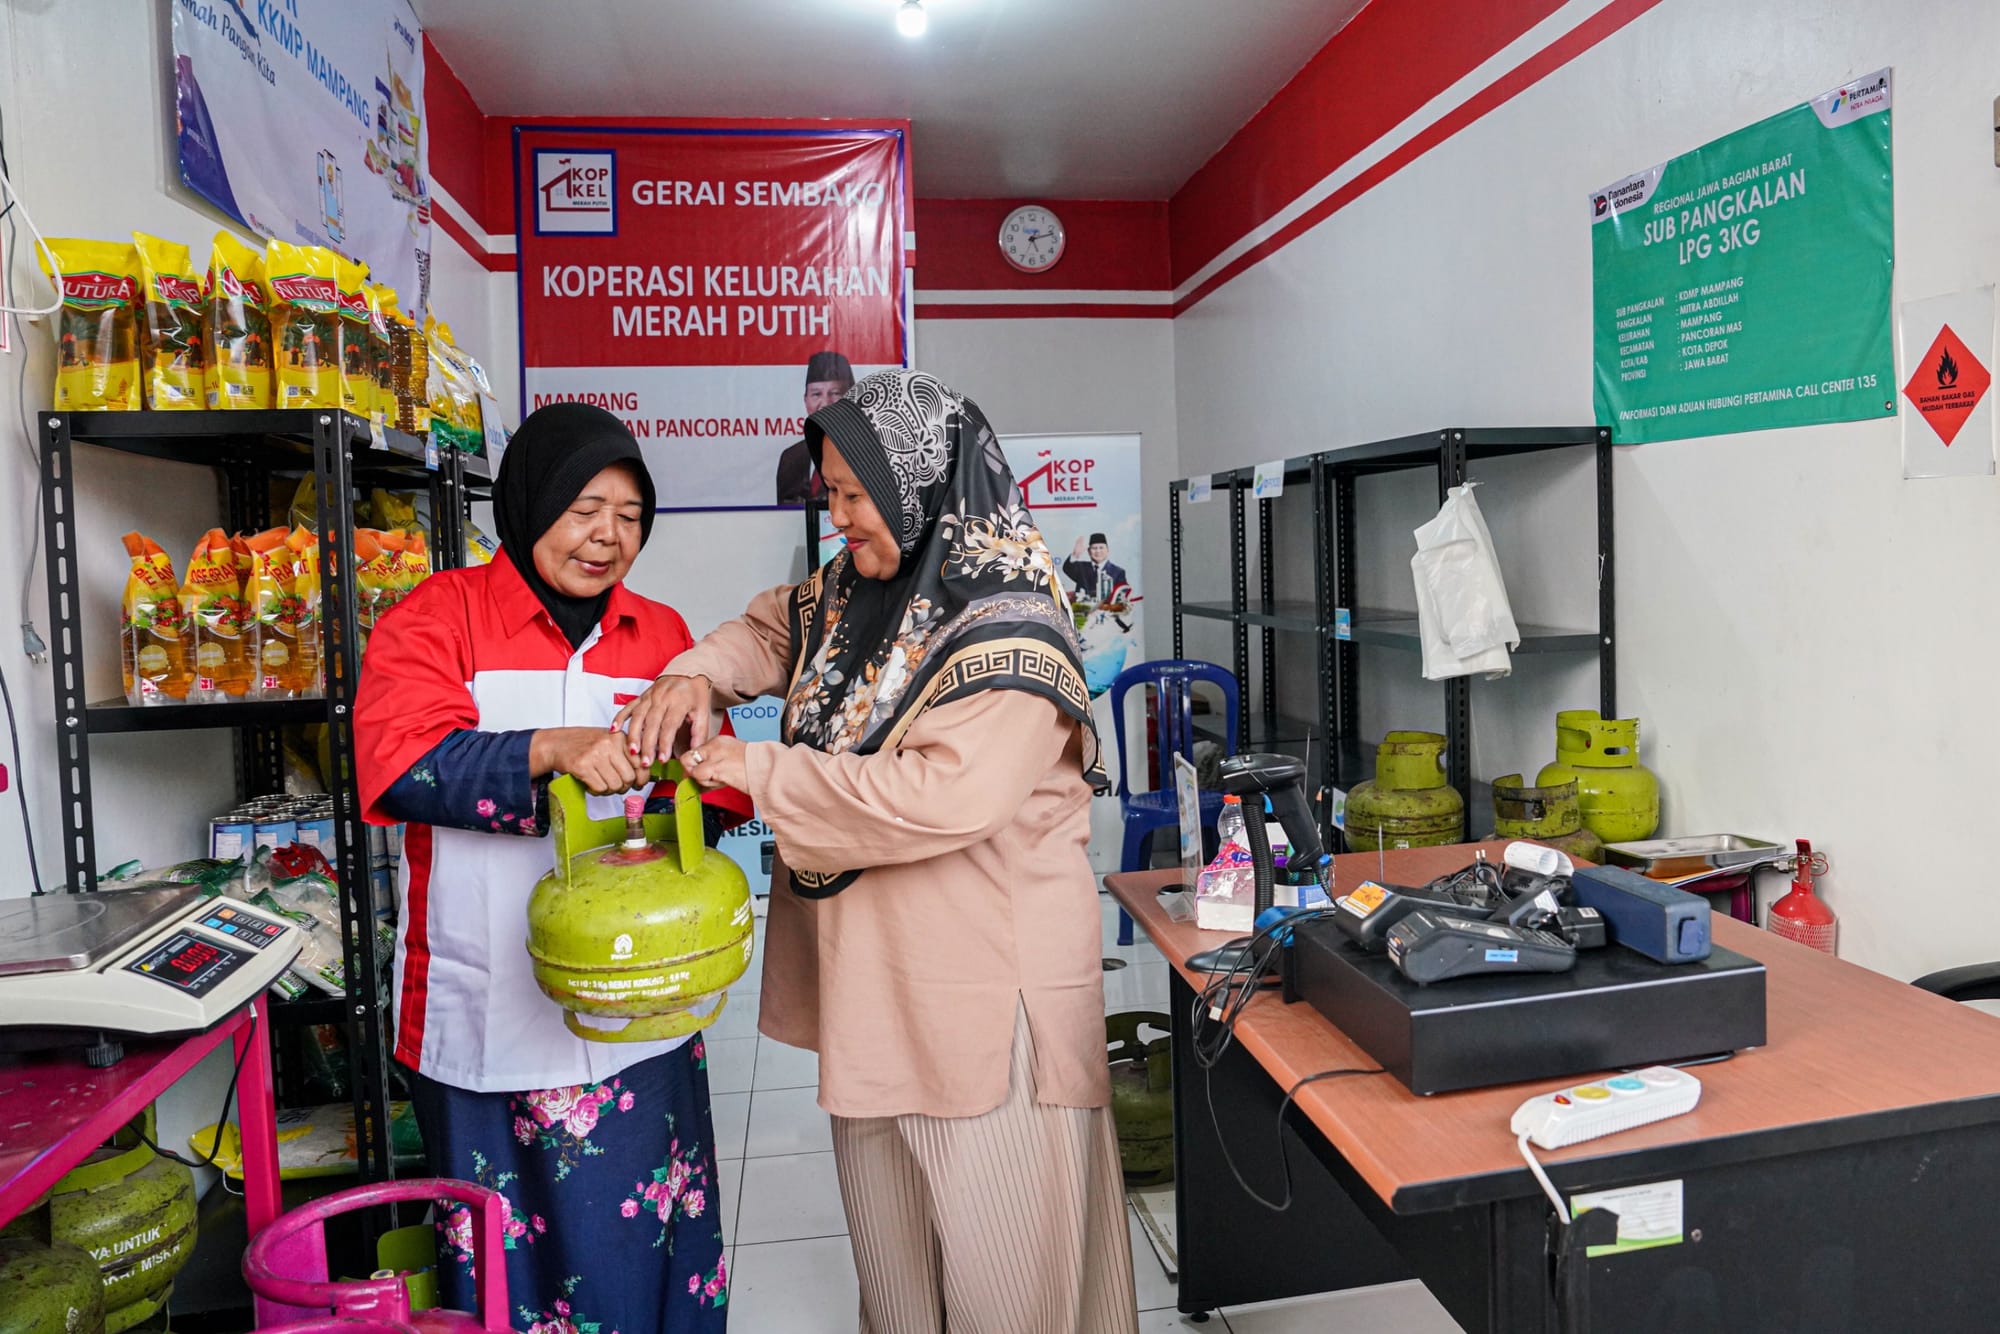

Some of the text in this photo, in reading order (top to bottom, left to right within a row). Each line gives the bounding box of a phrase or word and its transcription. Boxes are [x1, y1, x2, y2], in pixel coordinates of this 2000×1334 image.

[221, 13, 257, 67] Pangan
[257, 52, 276, 87] Kita
[257, 2, 370, 129] KKMP MAMPANG
[572, 167, 609, 181] KOP
[1653, 152, 1793, 215] REGIONAL JAWA BAGIAN BARAT
[572, 184, 607, 197] KEL
[631, 179, 886, 208] GERAI SEMBAKO
[1643, 168, 1806, 247] SUB PANGKALAN
[1679, 218, 1761, 266] LPG 3KG
[63, 279, 131, 299] UTURA
[543, 264, 889, 298] KOPERASI KELURAHAN
[1626, 296, 1665, 315] PANGKALAN
[1701, 276, 1744, 296] MAMPANG
[612, 304, 831, 338] MERAH PUTIH
[1616, 292, 1739, 330] PANGKALAN MITRA ABDILLAH
[1680, 311, 1723, 329] MAMPANG
[1620, 321, 1743, 356] KECAMATAN PANCORAN MAS
[1682, 344, 1703, 357] KOTA
[1704, 339, 1728, 353] DEPOK
[1621, 353, 1729, 382] PROVINSI JAWA BARAT
[534, 392, 639, 412] MAMPANG
[1619, 374, 1877, 421] INFORMASI DAN ADUAN HUBUNGI PERTAMINA CALL CENTER 135
[1962, 390, 1975, 399] GAS
[655, 418, 759, 438] PANCORAN
[764, 417, 806, 436] MAS
[1053, 459, 1095, 475] KOP
[1054, 477, 1094, 492] KEL
[731, 706, 778, 720] FOOD
[113, 1225, 161, 1256] UNTUK
